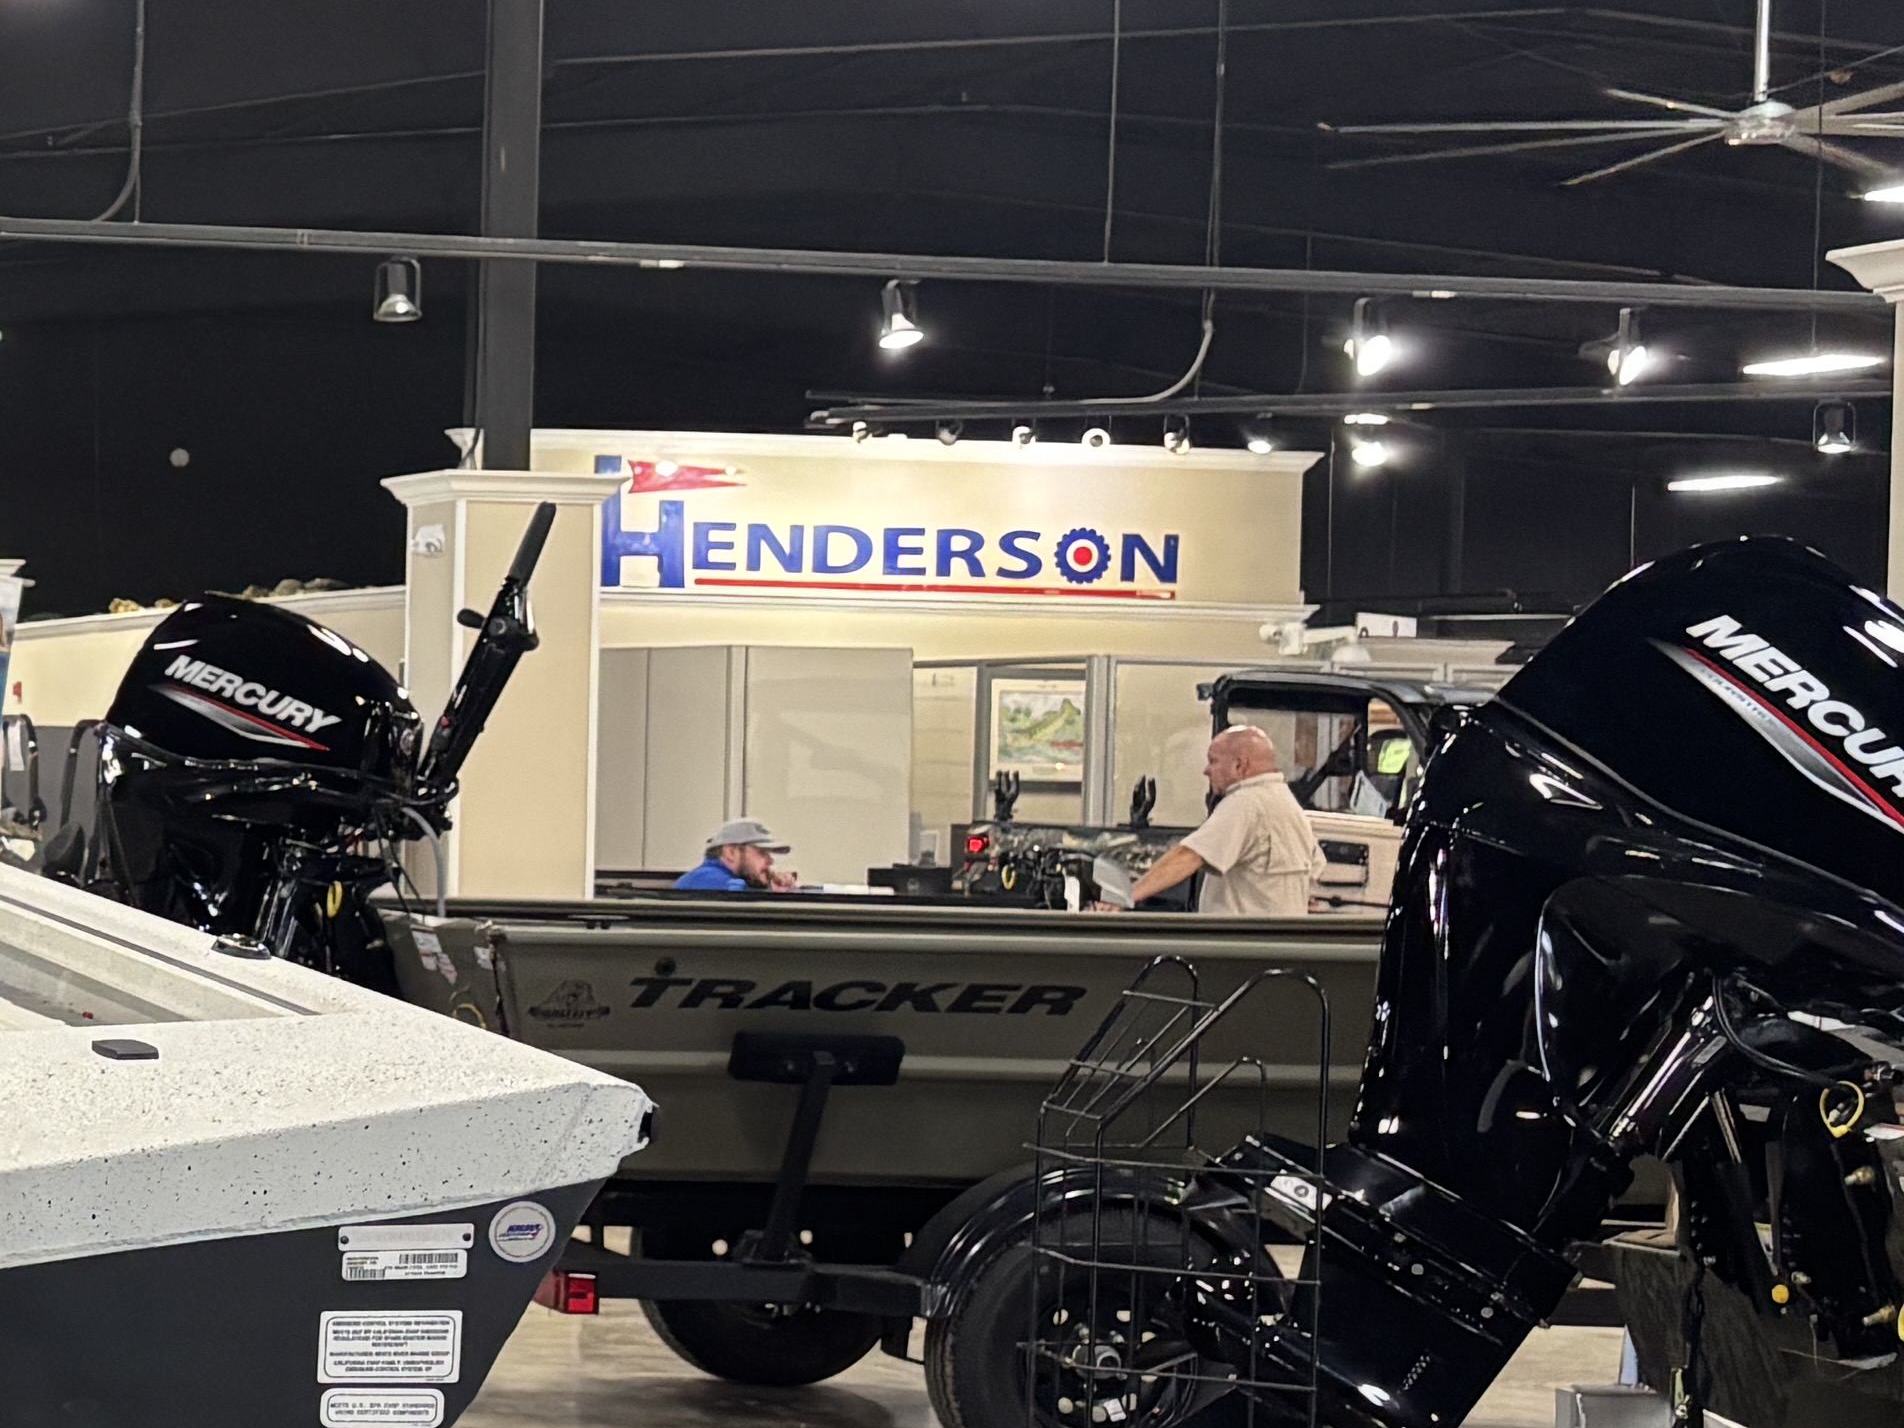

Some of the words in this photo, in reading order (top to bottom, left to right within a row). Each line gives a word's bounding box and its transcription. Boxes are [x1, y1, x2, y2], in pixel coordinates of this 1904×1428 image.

[594, 455, 1180, 588] HENDERSON
[164, 654, 342, 733] MERCURY
[629, 976, 1088, 1016] TRACKER
